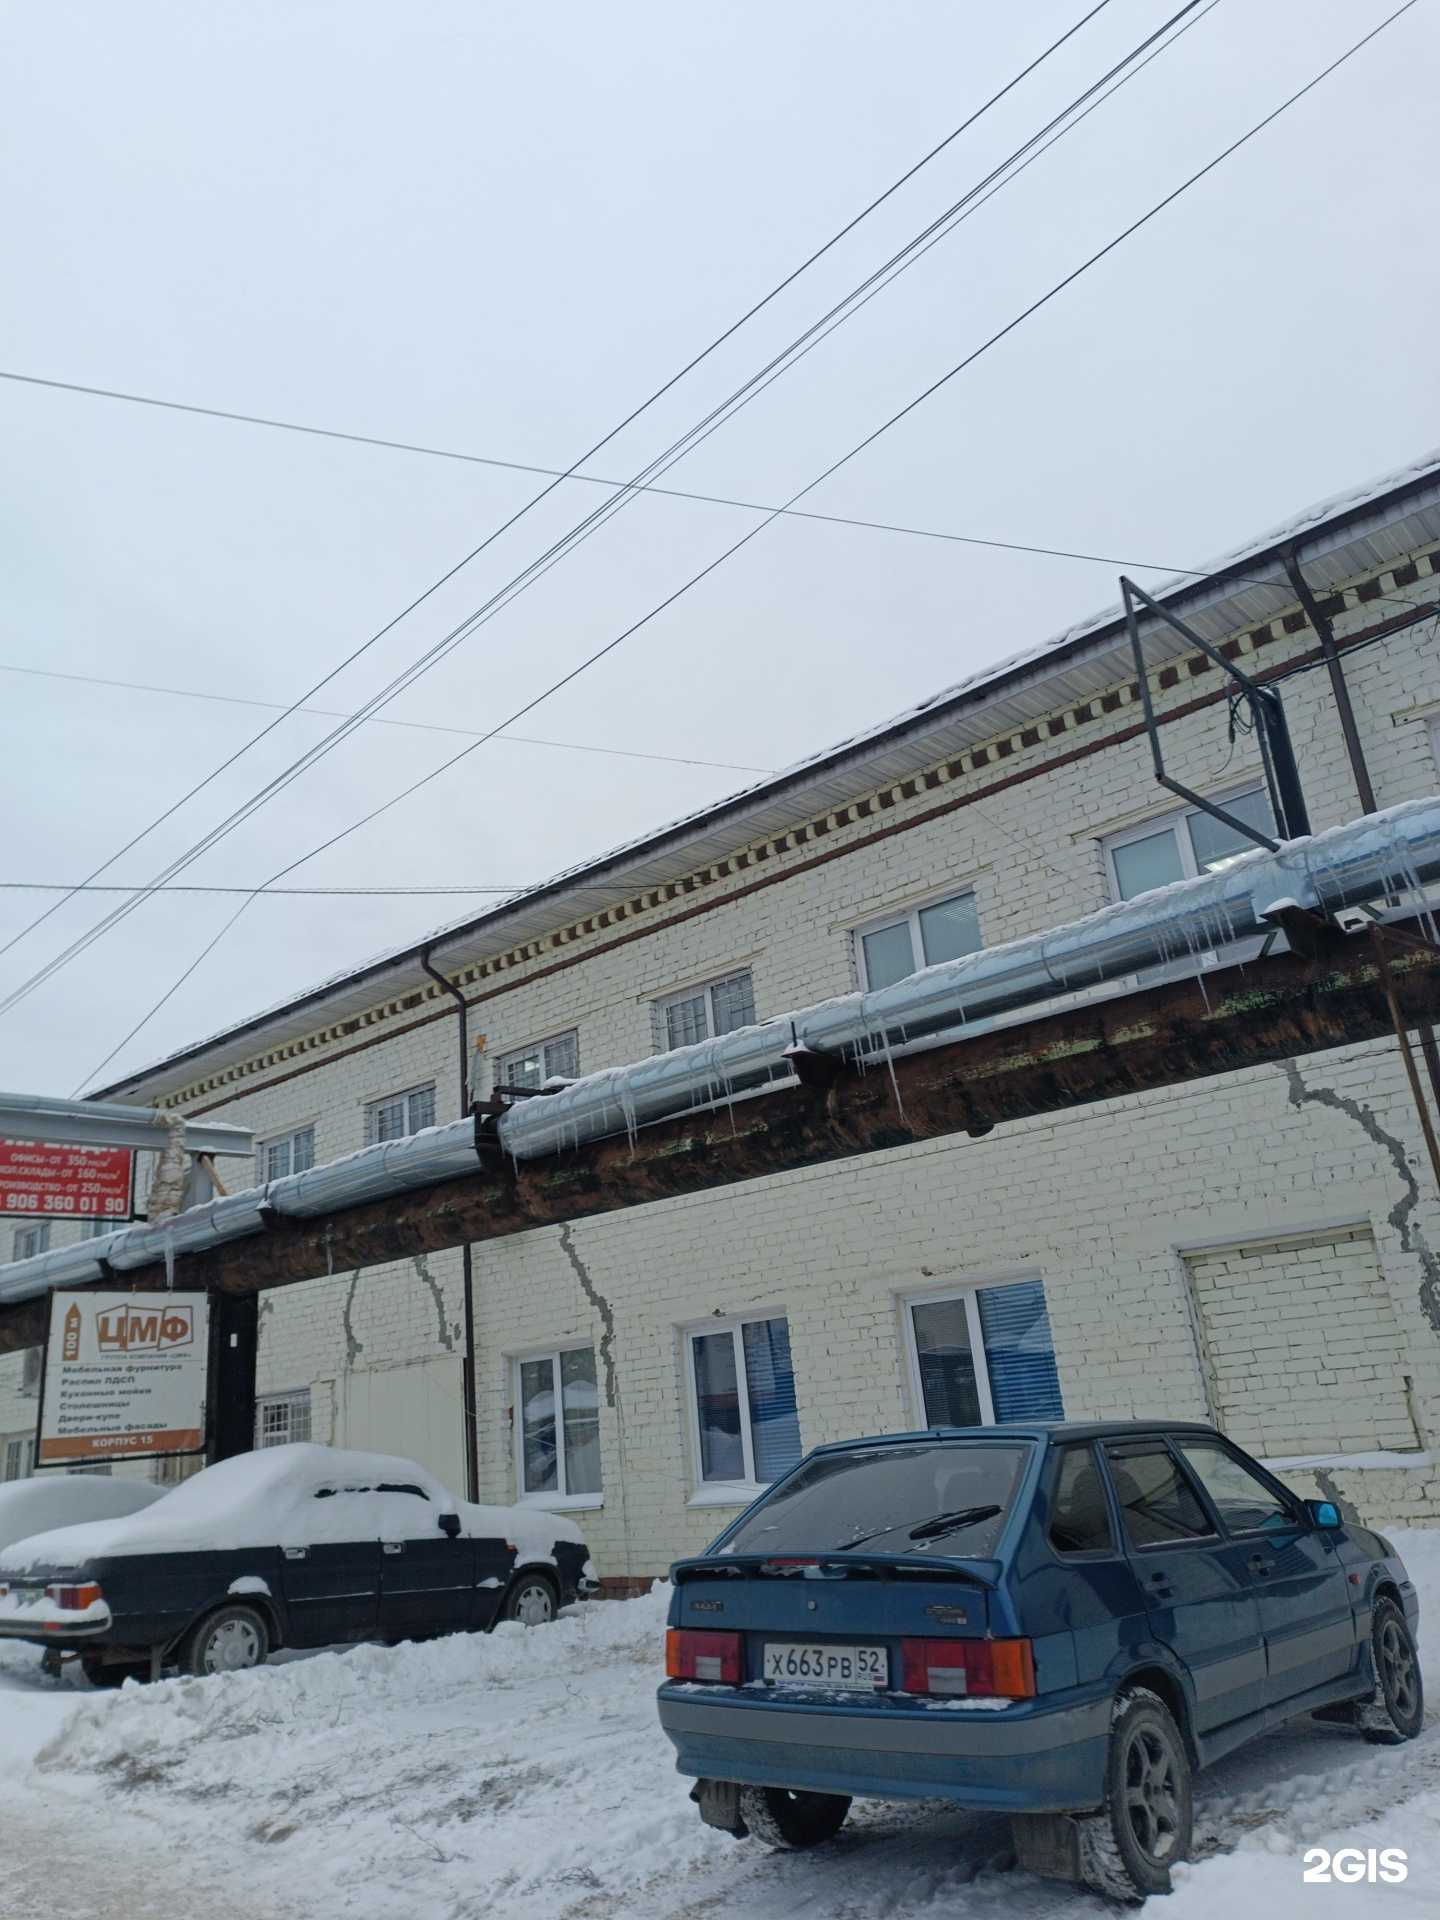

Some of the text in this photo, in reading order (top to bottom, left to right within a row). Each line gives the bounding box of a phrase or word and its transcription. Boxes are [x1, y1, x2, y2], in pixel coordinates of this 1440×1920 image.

[6, 1193, 38, 1209] 906
[43, 1195, 74, 1210] 360
[80, 1197, 98, 1211] 01
[105, 1198, 124, 1212] 90
[99, 1316, 189, 1352] ЦМФ
[65, 1332, 78, 1358] 100
[62, 1363, 183, 1375] Мебельная фурнитура
[104, 1376, 136, 1385] ЛДСП
[60, 1389, 115, 1399] Кухонные
[59, 1400, 130, 1411] Столешницы
[58, 1413, 121, 1424] Двери-купе
[58, 1421, 168, 1435] Мебельные фасады
[91, 1435, 153, 1448] КОРПУС 15
[772, 1648, 879, 1678] Х663РВ 52
